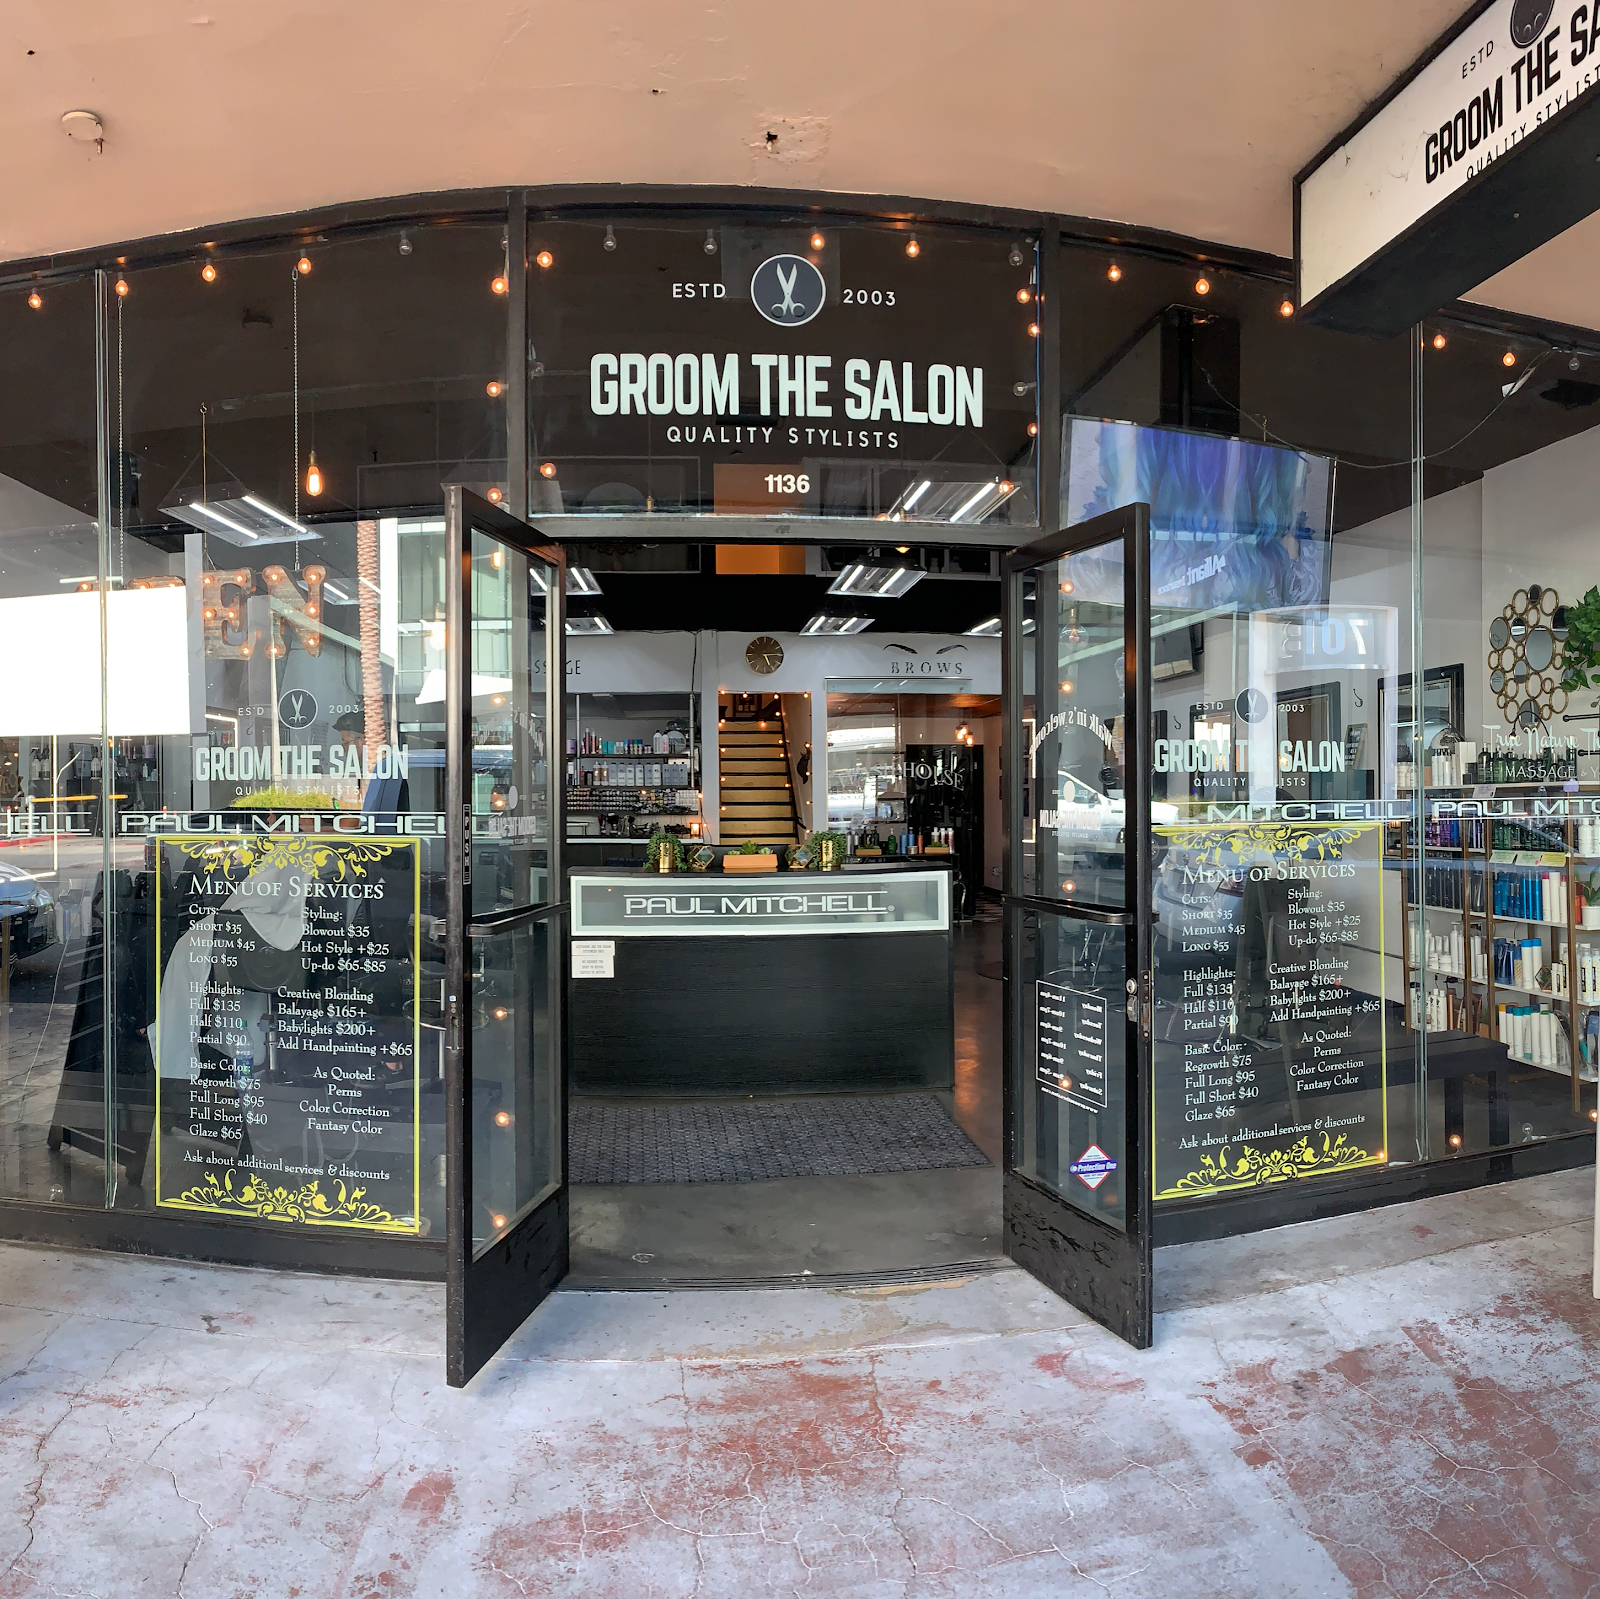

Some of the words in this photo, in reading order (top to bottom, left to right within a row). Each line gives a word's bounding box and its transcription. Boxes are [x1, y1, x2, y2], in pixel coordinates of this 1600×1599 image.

[1462, 40, 1494, 79] ESTD
[1426, 75, 1503, 184] GROOM
[1511, 26, 1560, 113] THE
[672, 283, 726, 298] ESTD
[843, 289, 896, 307] 2003
[590, 353, 739, 416] GROOM
[752, 354, 832, 418] THE
[845, 358, 983, 427] SALON
[667, 426, 773, 444] QUALITY
[788, 427, 899, 448] STYLISTS
[764, 474, 810, 493] 1136
[891, 662, 963, 674] BROWS
[238, 707, 264, 716] ESD
[329, 705, 359, 714] 2003
[1196, 702, 1224, 710] ESTD
[1280, 704, 1304, 712] 2003
[1482, 724, 1522, 758] True
[1524, 725, 1580, 754] Nature
[195, 747, 270, 781] GROOM
[280, 745, 321, 779] THE
[329, 744, 408, 779] SALON
[1154, 739, 1229, 773] GROOM
[1280, 741, 1345, 772] SALON
[1505, 766, 1577, 778] MASSAGE
[1194, 778, 1246, 787] QUALITY
[1207, 801, 1410, 822] MITCHELL
[1434, 801, 1529, 817] PAUL
[121, 814, 236, 833] PAUL
[1182, 864, 1245, 885] MENU
[1250, 868, 1273, 882] OF
[1277, 861, 1356, 882] SERVICES
[289, 876, 384, 900] SERVICES
[1287, 887, 1323, 902] Styling:
[626, 897, 715, 914] PAUL
[721, 894, 887, 914] MITCHELL
[1182, 894, 1211, 904] CUTS:
[189, 904, 219, 915] CUTS:
[302, 907, 342, 922] Styling:
[1182, 910, 1215, 920] SHORT
[1217, 909, 1232, 920] $35
[1288, 904, 1325, 915] Blowout
[1327, 902, 1345, 912] $35
[189, 920, 223, 932] SHORT
[225, 923, 242, 935] $35
[1182, 925, 1226, 936] MEDIUM
[1228, 924, 1245, 935] $45
[1288, 920, 1307, 930] Hot
[1310, 918, 1332, 930] Style
[1335, 915, 1360, 927] +$25
[301, 924, 345, 937] Blowout
[348, 926, 370, 938] $35
[189, 936, 234, 948] MEDIUM
[237, 940, 255, 951] $45
[1182, 942, 1210, 952] LONG
[1213, 941, 1230, 951] $55
[1289, 934, 1317, 947] Up-do
[1320, 931, 1358, 944] $65-$85
[301, 942, 322, 953] Hot
[326, 943, 353, 956] Style
[357, 944, 389, 956] +$25
[189, 953, 218, 964] LONG
[221, 955, 237, 967] $55
[301, 958, 335, 972] Up-do
[337, 960, 386, 973] $65-$85
[1269, 962, 1306, 975] Creative
[1309, 958, 1349, 973] Blonding
[1183, 969, 1236, 982] Highlights:
[1270, 978, 1309, 991] Balayage
[1311, 975, 1343, 986] $165+
[189, 982, 245, 996] Highlights:
[278, 987, 322, 1000] Creative
[325, 988, 374, 1004] Blonding
[1184, 986, 1204, 998] Full
[189, 999, 210, 1010] Full
[213, 1000, 241, 1012] $135
[1270, 993, 1317, 1008] Babylights
[1319, 989, 1351, 1001] $200+
[278, 1004, 324, 1019] Balayage
[327, 1005, 367, 1018] $165+
[1184, 1000, 1206, 1014] Half
[1270, 1011, 1290, 1023] Add
[1292, 1005, 1352, 1020] Handpainting
[1355, 1000, 1380, 1013] +$65
[189, 1015, 211, 1027] Half
[215, 1017, 242, 1029] $110
[278, 1021, 332, 1036] Babylights
[335, 1023, 376, 1036] $200+
[1184, 1019, 1216, 1031] Partial
[189, 1032, 223, 1045] Partial
[226, 1033, 247, 1046] $90
[277, 1038, 300, 1050] Add
[303, 1039, 376, 1057] Handpainting
[380, 1043, 413, 1057] +$65
[1184, 1045, 1210, 1056] Basic
[1213, 1041, 1243, 1053] Color:
[190, 1058, 216, 1070] Basic
[219, 1060, 251, 1072] Color:
[1185, 1060, 1230, 1075] Regrowth
[1232, 1055, 1252, 1067] $75
[1289, 1065, 1315, 1077] Color
[1318, 1059, 1364, 1073] Correction
[313, 1067, 327, 1079] As
[330, 1068, 375, 1082] Quoted:
[1185, 1076, 1205, 1089] Full
[1208, 1075, 1233, 1088] Long
[1235, 1071, 1256, 1083] $95
[190, 1075, 236, 1090] Regrowth
[239, 1078, 261, 1090] $75
[1296, 1078, 1332, 1092] Fantasy
[1334, 1075, 1359, 1086] Color
[328, 1084, 362, 1098] Perms
[190, 1091, 210, 1103] Full
[214, 1093, 240, 1108] Long
[243, 1095, 264, 1108] $95
[300, 1100, 330, 1113] Color
[333, 1103, 390, 1117] Correction
[190, 1108, 210, 1120] Full
[214, 1110, 243, 1123] Short
[246, 1111, 268, 1125] $40
[189, 1125, 218, 1138] Glaze
[221, 1126, 242, 1140] $65
[308, 1118, 349, 1133] Fantasy
[352, 1122, 382, 1135] Color
[184, 1150, 204, 1163] Ask
[206, 1154, 234, 1166] about
[285, 1163, 324, 1176] services
[339, 1167, 390, 1180] discounts
